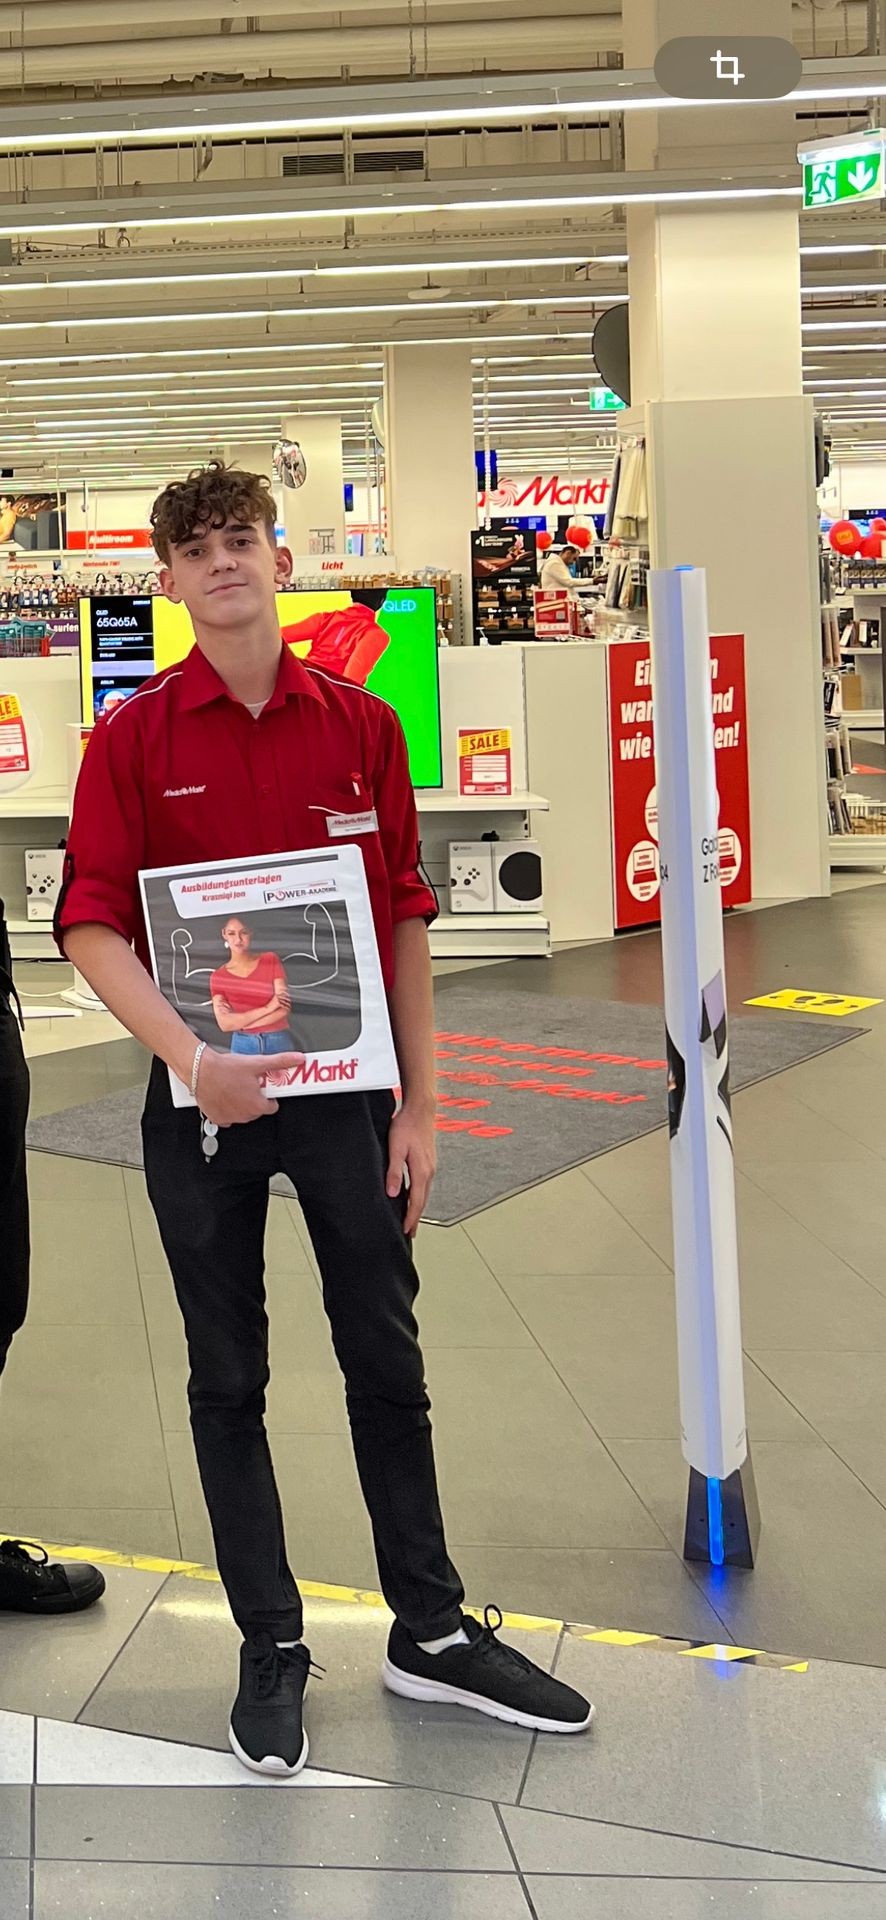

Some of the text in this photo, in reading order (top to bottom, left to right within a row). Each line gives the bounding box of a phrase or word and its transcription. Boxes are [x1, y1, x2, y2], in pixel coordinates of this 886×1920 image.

[321, 561, 344, 570] Licht
[383, 600, 416, 612] QLED
[96, 617, 138, 627] 65Q65A
[634, 659, 651, 687] Ei
[712, 686, 734, 714] nd
[470, 735, 499, 750] SALE
[619, 721, 740, 761] wie en!
[703, 864, 709, 883] Z
[181, 873, 282, 893] Ausbildungsunterlagen
[234, 890, 246, 900] Jon
